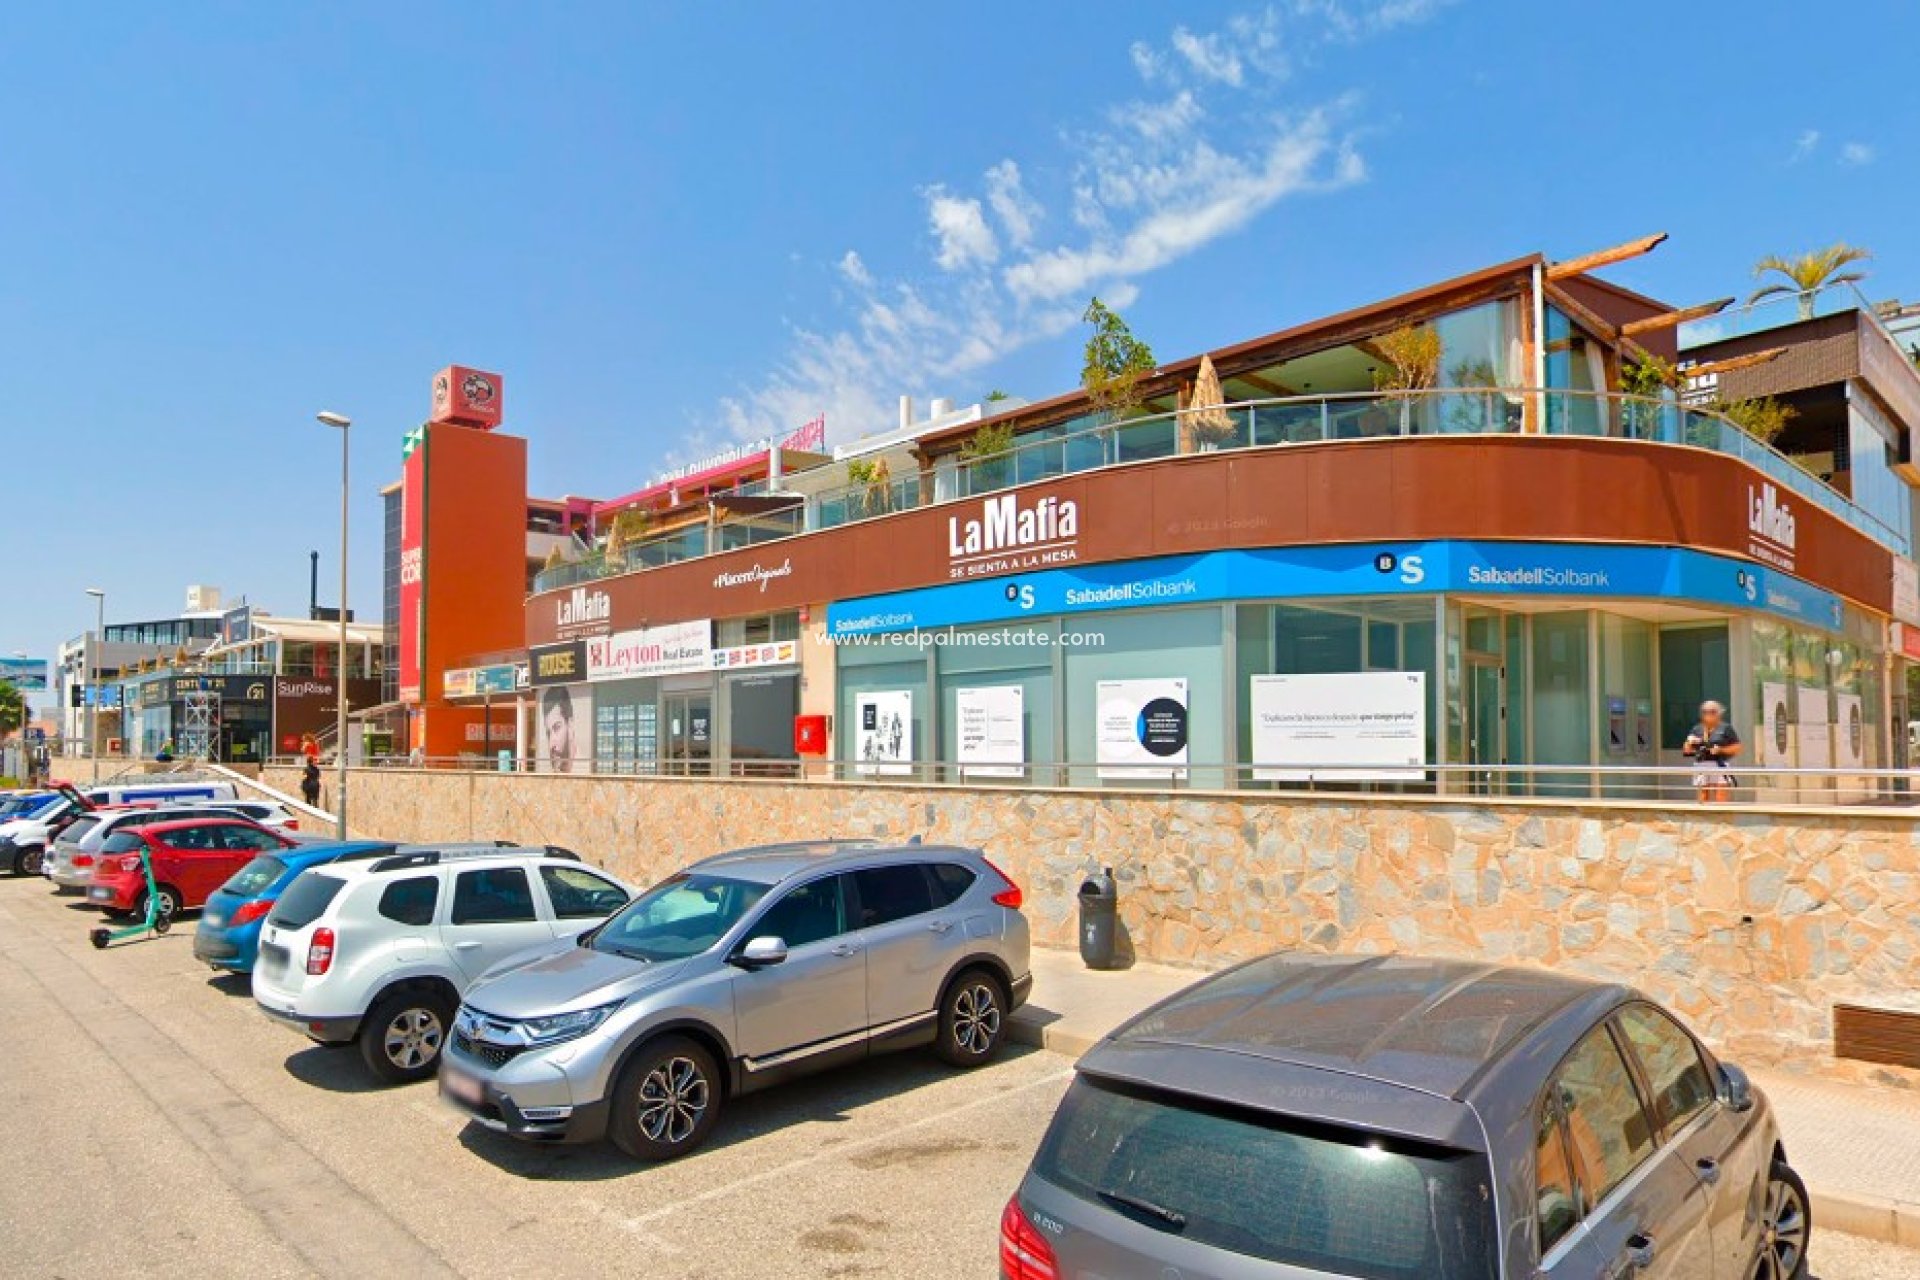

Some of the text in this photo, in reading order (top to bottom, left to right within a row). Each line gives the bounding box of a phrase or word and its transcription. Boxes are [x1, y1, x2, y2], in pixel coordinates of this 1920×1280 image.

[967, 560, 1008, 576] SIENTA
[1023, 556, 1038, 567] LA
[1042, 549, 1077, 563] MESA
[604, 639, 661, 674] Leyton
[278, 681, 332, 696] SunRise
